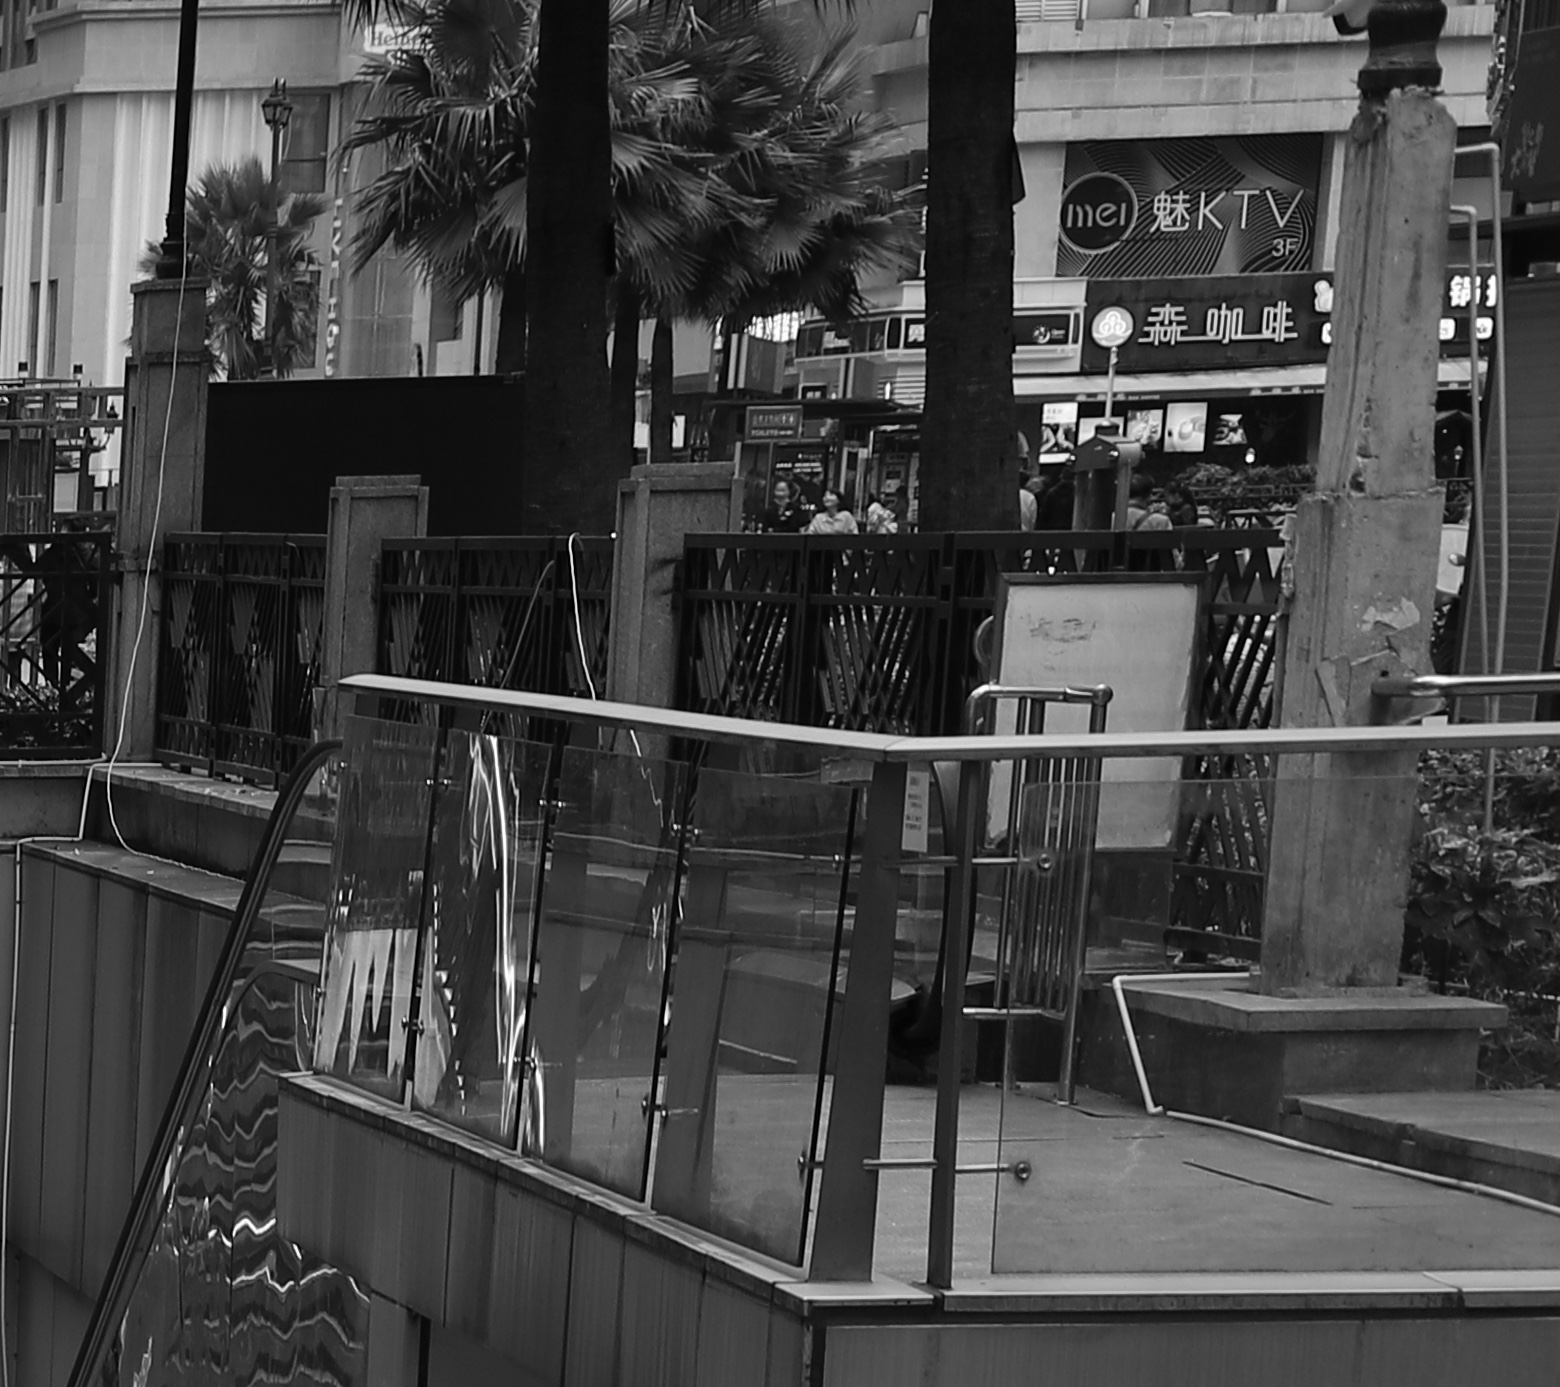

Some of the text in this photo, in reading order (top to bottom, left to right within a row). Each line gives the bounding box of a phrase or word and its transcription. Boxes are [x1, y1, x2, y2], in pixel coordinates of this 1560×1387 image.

[1150, 189, 1304, 233] 魅KTV
[1271, 239, 1298, 257] 3F
[1138, 301, 1298, 345] 森咖啡
